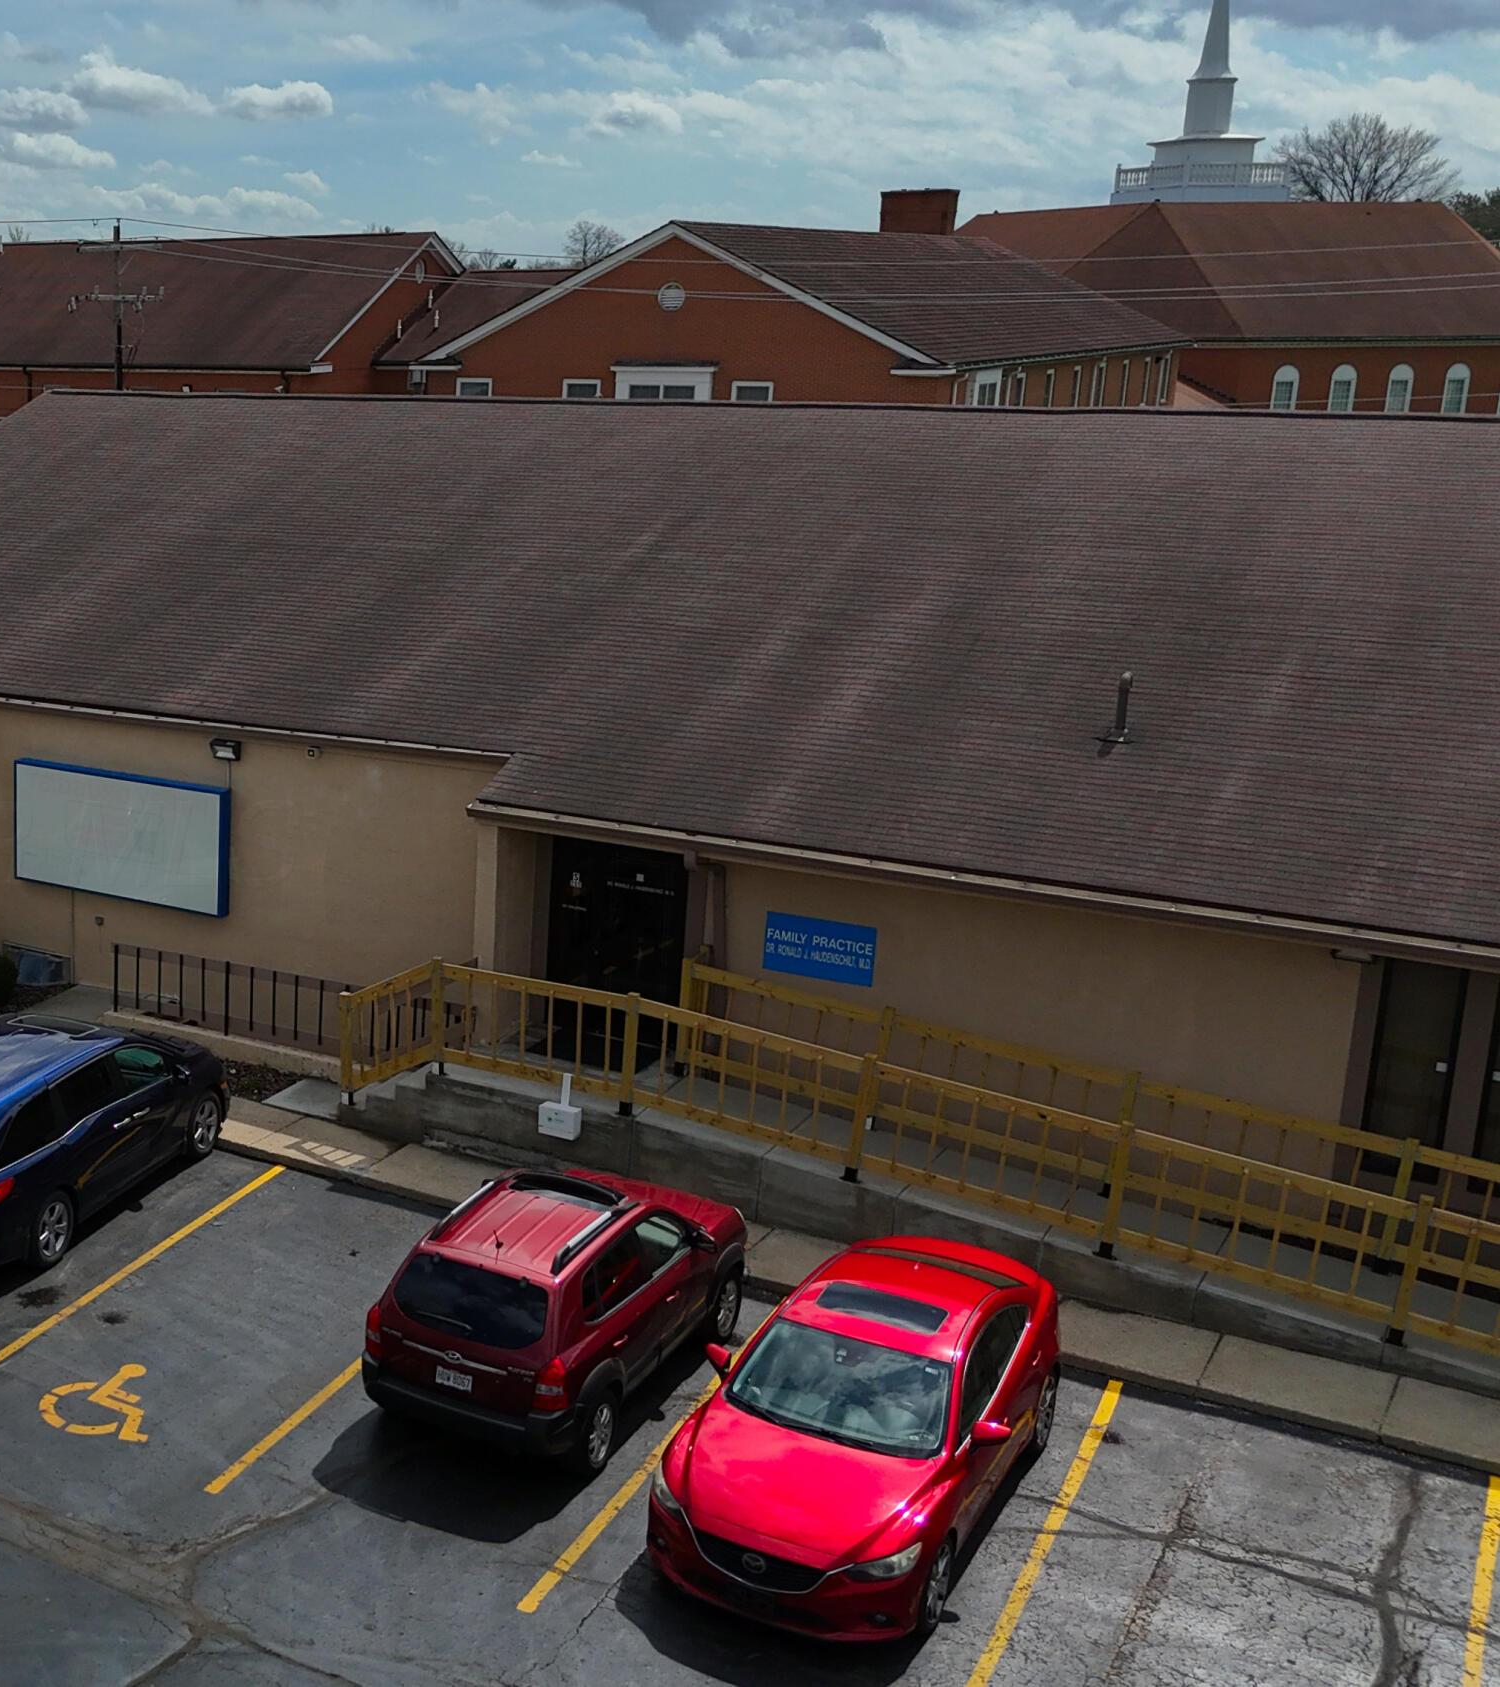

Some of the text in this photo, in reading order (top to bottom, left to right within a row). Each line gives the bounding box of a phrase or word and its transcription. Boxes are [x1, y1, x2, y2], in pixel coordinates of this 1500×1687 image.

[766, 928, 874, 956] FAMILY PRACTICE
[777, 944, 803, 959] RONALD
